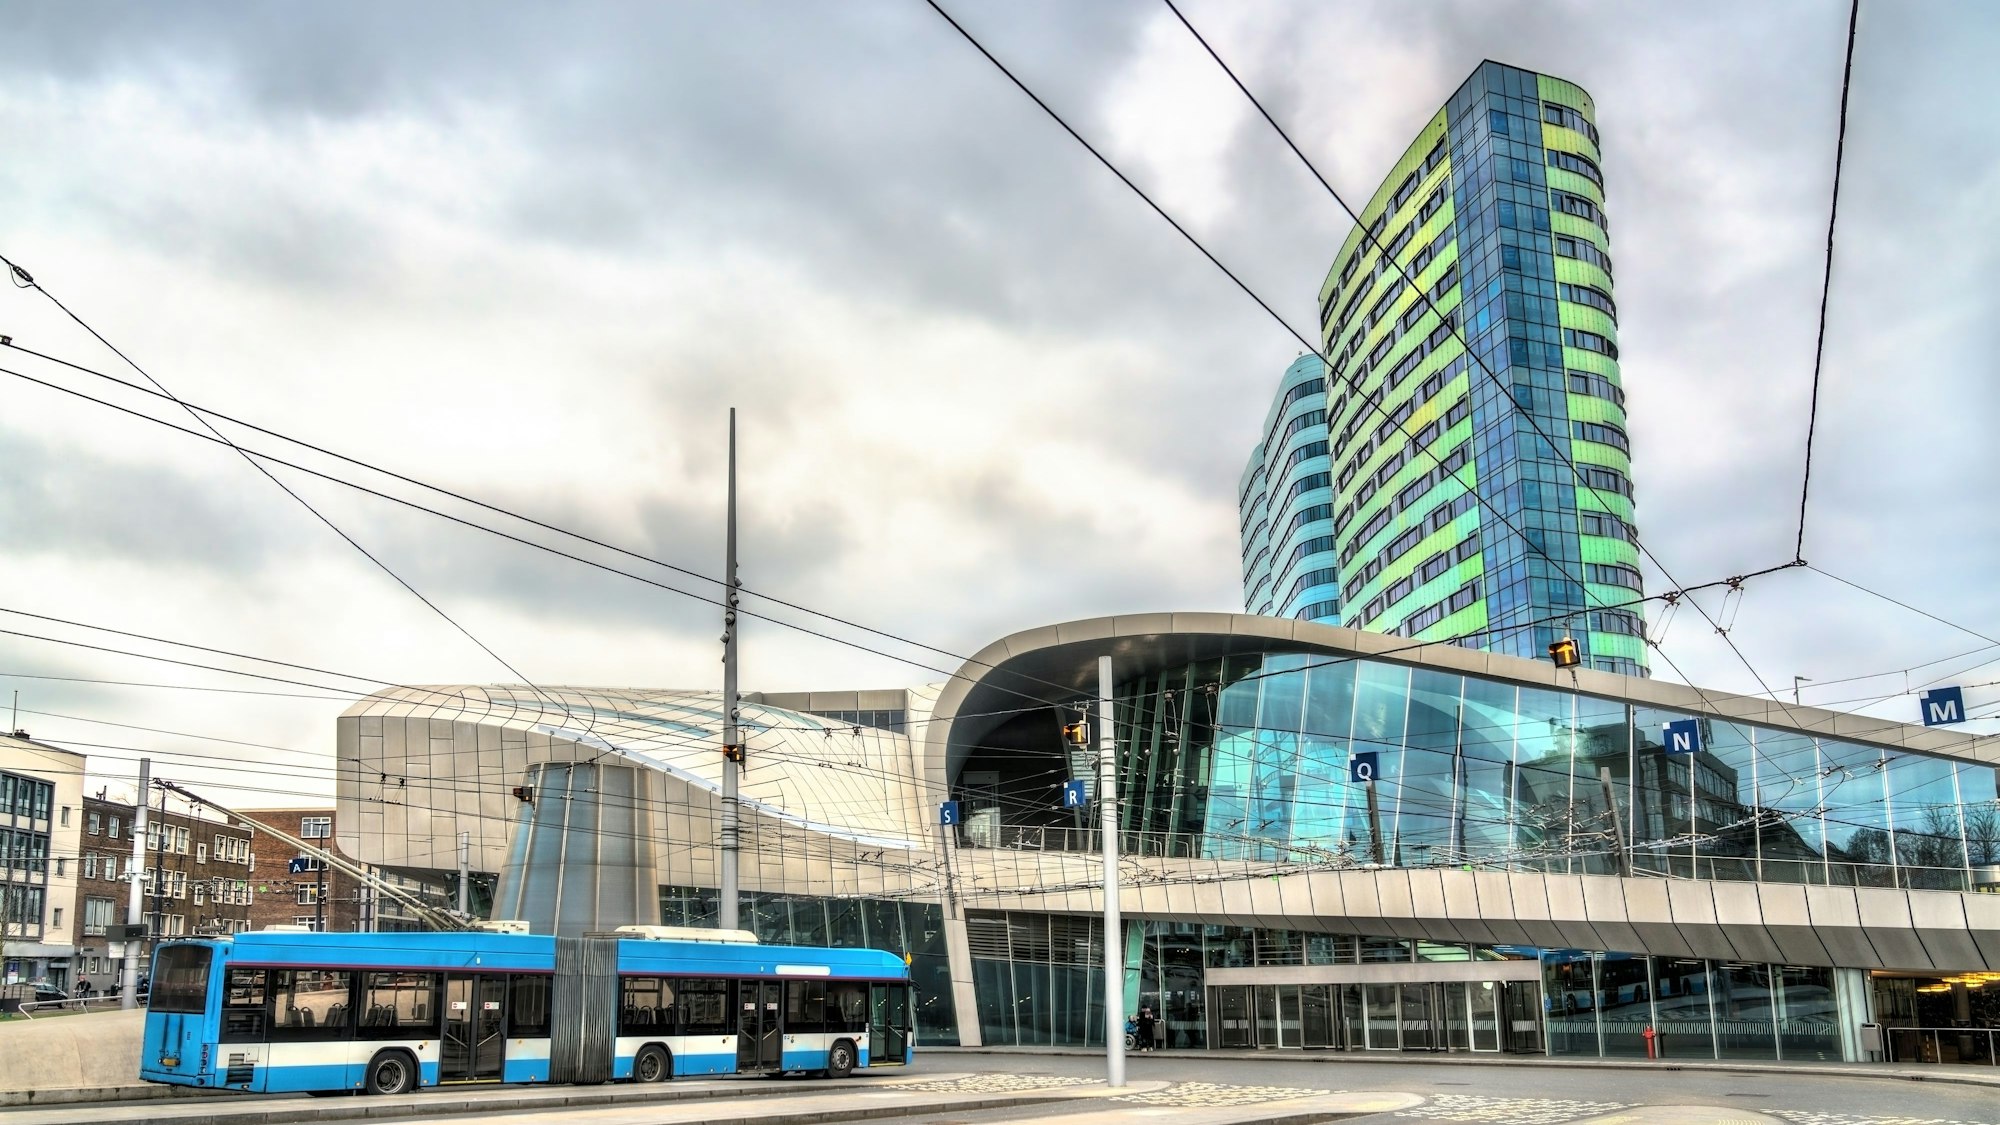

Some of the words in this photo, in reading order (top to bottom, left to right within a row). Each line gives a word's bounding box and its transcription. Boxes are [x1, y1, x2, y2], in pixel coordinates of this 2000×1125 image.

[1930, 700, 1957, 723] M
[1673, 732, 1690, 751] N
[1357, 763, 1372, 781] Q
[1069, 790, 1077, 804] R
[944, 810, 951, 823] S
[293, 863, 301, 873] A
